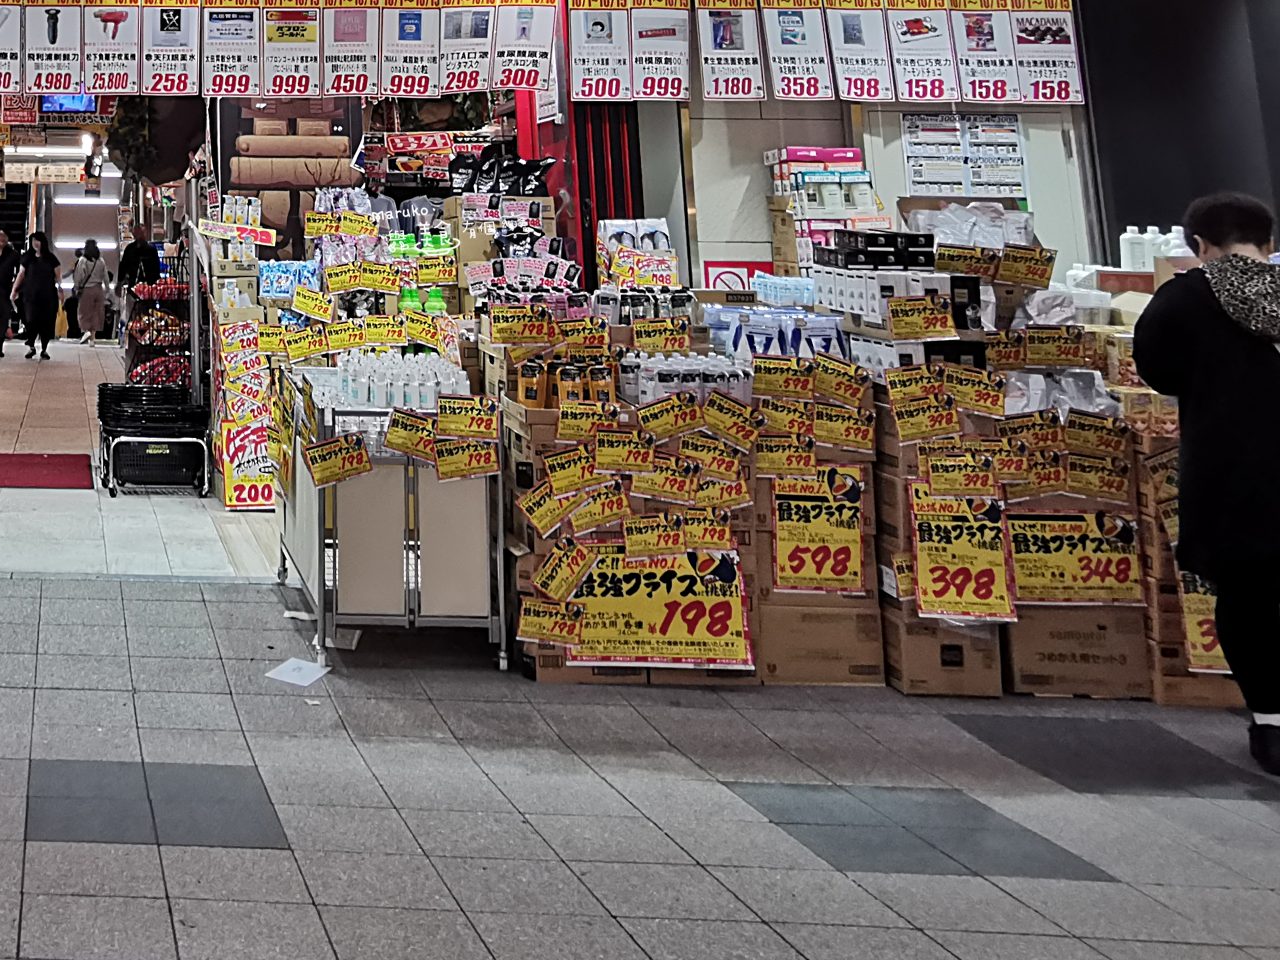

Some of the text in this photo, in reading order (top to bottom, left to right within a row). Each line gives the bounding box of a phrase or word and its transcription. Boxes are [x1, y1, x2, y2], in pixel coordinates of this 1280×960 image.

[1016, 17, 1068, 26] MACADAMIA
[34, 73, 70, 91] 4,980
[93, 73, 128, 90] 25,800
[151, 74, 188, 91] 258
[212, 75, 249, 93] 999
[272, 74, 310, 94] 999
[332, 74, 368, 93] 450
[390, 76, 430, 94] 999
[446, 70, 479, 89] 298
[500, 69, 539, 87] 300
[581, 78, 620, 97] 500
[642, 77, 682, 97] 999
[713, 77, 752, 96] 1,180
[781, 77, 819, 97] 358
[844, 78, 879, 97] 798
[905, 79, 944, 98] 158
[969, 80, 1007, 99] 158
[1030, 81, 1070, 100] 158
[468, 416, 493, 430] 198
[340, 452, 364, 470] 198
[468, 452, 491, 466] 198
[233, 484, 272, 502] 200
[788, 544, 851, 576] 598
[1078, 556, 1131, 584] 348
[929, 566, 995, 600] 398
[659, 600, 732, 637] 198
